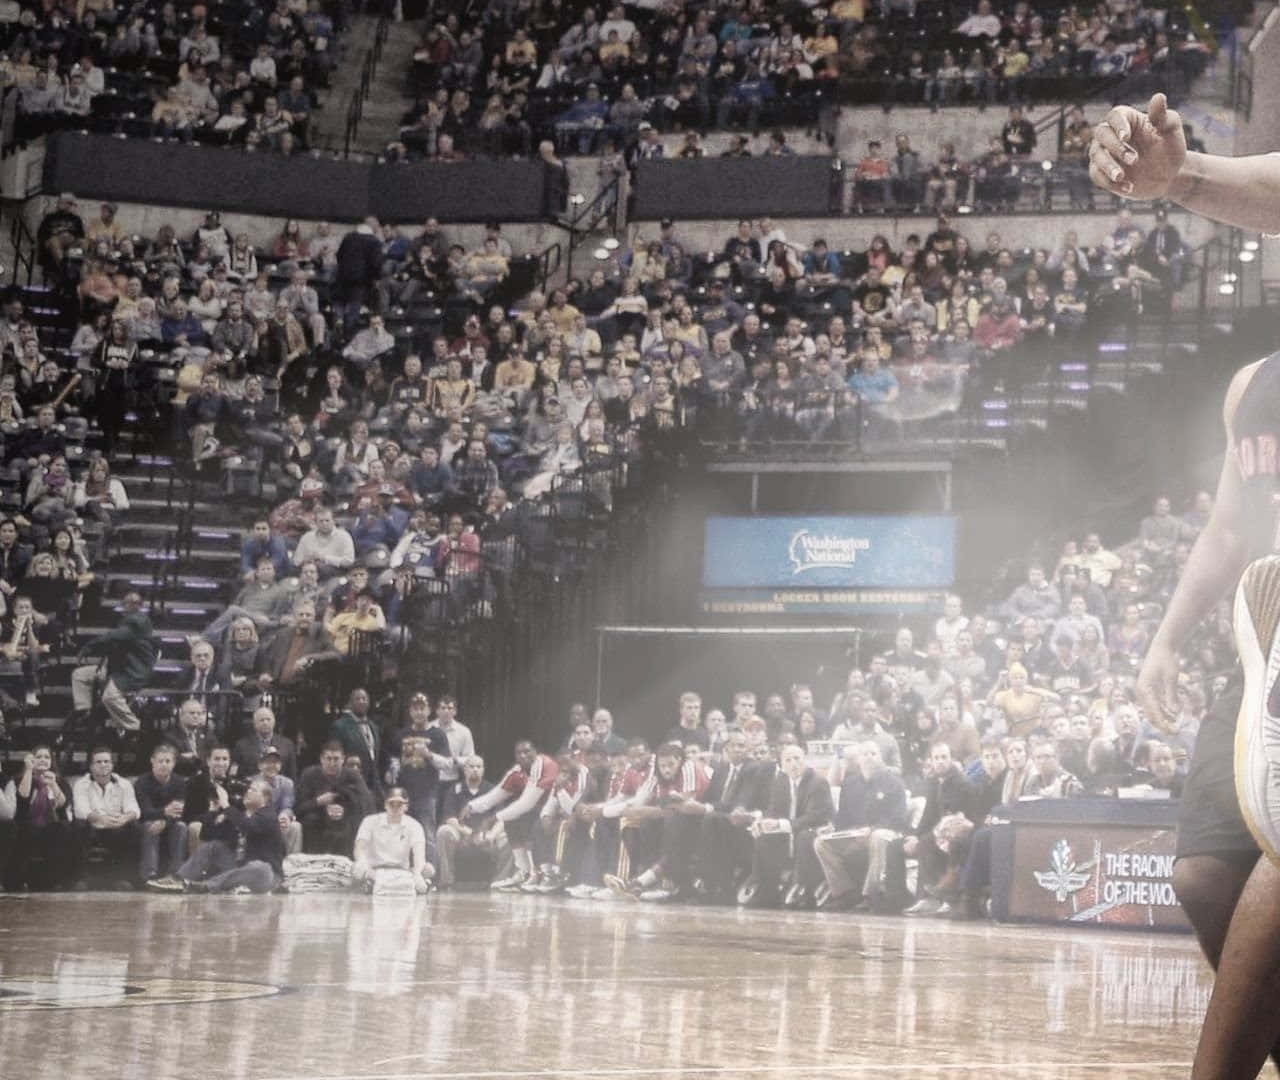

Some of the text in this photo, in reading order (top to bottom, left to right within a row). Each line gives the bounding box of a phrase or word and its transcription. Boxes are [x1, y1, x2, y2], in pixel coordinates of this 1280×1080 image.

[801, 535, 871, 553] Washington
[806, 549, 856, 563] National
[1105, 853, 1131, 877] THE
[1104, 881, 1122, 903] OF
[1123, 881, 1150, 904] THE
